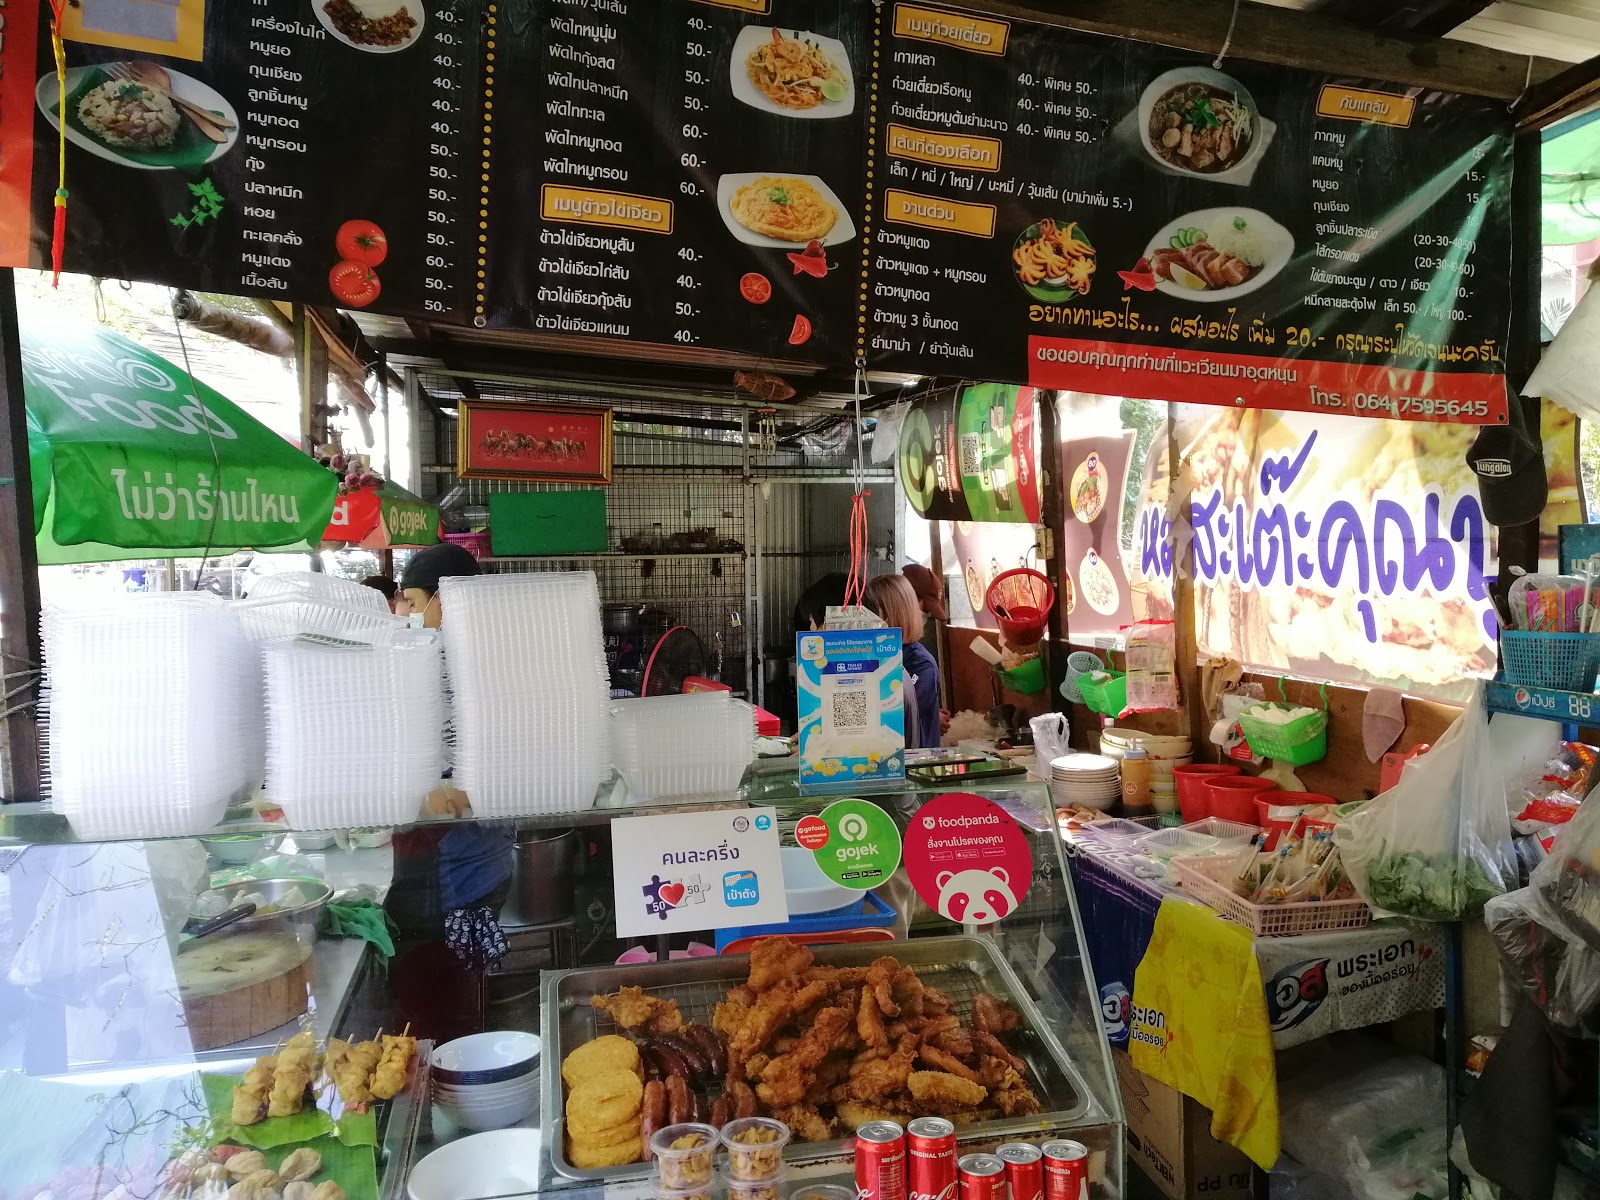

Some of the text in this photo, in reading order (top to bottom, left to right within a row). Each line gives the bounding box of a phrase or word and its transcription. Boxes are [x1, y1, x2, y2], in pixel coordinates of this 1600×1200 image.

[434, 9, 464, 24] 40.-
[687, 18, 712, 30] 40.-
[251, 16, 326, 40] เครื่องในไก่
[551, 17, 616, 43] ผัดไทหมูนุ่ม
[907, 18, 991, 47] เมนูก๋วยเตี๋ยว
[435, 33, 462, 45] 40.-
[250, 41, 291, 56] หมูยอ
[549, 43, 615, 70] ผัดไทกุ้งสด
[687, 42, 711, 57] 50.-
[434, 55, 461, 67] 40.-
[894, 52, 935, 66] เกาเหลา
[249, 65, 302, 81] กุนเชียง
[685, 70, 709, 84] 50.-
[433, 77, 461, 90] 40.-
[548, 72, 628, 100] ผัดไทปลาหมึก
[893, 75, 971, 104] ก๋วยเตี๋ยวเรือหมู
[1018, 73, 1097, 94] 40.- พิเศษ 50.-
[248, 87, 307, 110] ลูกชิ้นหมู
[432, 100, 460, 112] 40.-
[684, 96, 709, 111] 50.-
[547, 100, 605, 121] ผัดไททะเล
[891, 103, 1008, 132] ก๋วยเตี๋ยวหมูต้มยำมะนาว
[1017, 98, 1096, 121] 40.- พิเศษ 50.-
[248, 112, 299, 128] หมูทอด
[431, 122, 459, 134] 40.-
[683, 124, 708, 138] 60.-
[1017, 123, 1096, 143] 40.- พิเศษ 50.-
[1314, 130, 1346, 148] กากหมู
[247, 135, 306, 152] หมูกรอบ
[545, 129, 622, 152] ผัดไทหมูทอด
[893, 134, 991, 162] เส้นที่ต้องเลือก
[431, 144, 458, 157] 50.-
[246, 156, 265, 172] กุ้ง
[681, 153, 706, 167] 60.-
[1312, 155, 1343, 172] แคบหมู
[430, 166, 457, 179] 50.-
[544, 158, 627, 181] ผัดไทหมูกรอบ
[1466, 171, 1486, 182] 15.-
[245, 182, 302, 199] ปลาหมึก
[680, 182, 704, 195] 60.-
[890, 161, 1132, 211] เล็ก / หมี่ / ใหญ่ / บะหมี่ / วุ้นเส้น (มาม่าเพิ่ม 5.-)
[1312, 177, 1339, 192] หมูยอ
[429, 189, 456, 201] 50.-
[244, 207, 275, 219] หอย
[554, 195, 662, 223] เมนูข้าวไข่เจียว
[902, 202, 955, 221] จานด่วน
[1313, 200, 1350, 213] กุนเชียง
[428, 211, 455, 223] 50.-
[243, 230, 302, 245] ทะเลคลั่ง
[427, 233, 454, 246] 50.-
[540, 229, 634, 254] ข้าวไข่เจียวหมูสับ
[878, 229, 930, 249] ข้าวหมูแดง
[242, 253, 291, 267] หมูแดง
[426, 256, 453, 268] 60.-
[678, 248, 703, 261] 40.-
[539, 258, 629, 280] ข้าวไข่เจียวไก่สับ
[876, 256, 928, 275] ข้าวหมูแดง
[945, 268, 986, 283] หมูกรอบ
[242, 272, 287, 289] เนื้อสับ
[425, 278, 452, 290] 50.-
[677, 275, 701, 288] 40.-
[1370, 276, 1374, 288] /
[1379, 276, 1398, 289] ดาว
[1401, 278, 1406, 289] /
[1410, 276, 1430, 292] เจียว
[538, 286, 631, 310] ข้าวไข่เจียวกุ้งสับ
[875, 282, 929, 302] ข้าวหมูทอด
[1454, 287, 1474, 299] 10.-
[425, 300, 452, 312] 50.-
[676, 302, 700, 316] 50.-
[1304, 294, 1377, 312] หมึกสายสะดุ้งไฟ
[1384, 298, 1399, 313] เล็ก
[1403, 302, 1422, 314] 50.-
[1447, 310, 1472, 322] 100.-
[536, 314, 629, 335] ข้าวไข่เจียวแหนม
[874, 309, 958, 330] ข้าวหมู 3 ชั้นทอด
[1029, 297, 1159, 333] อยากทานอะไร...
[1171, 305, 1239, 341] ผสมอะไร
[1248, 312, 1275, 344] เพิ่ม
[1286, 326, 1326, 348] 20.-
[674, 330, 699, 342] 40.-
[872, 338, 973, 358] ยำมาม่า / ยำวุ้นเส้น
[1309, 386, 1346, 407] โทร.
[34, 373, 238, 440] Food
[934, 424, 947, 491] gojek
[111, 468, 300, 524] ไม่ว่าร้านไหน
[399, 509, 428, 536] gojek
[876, 645, 897, 653] เป๋าตัง
[804, 824, 826, 834] gofood
[937, 813, 1000, 832] foodpanda
[661, 838, 740, 866] คนละครึ่ง
[836, 843, 879, 862] gojek
[652, 884, 700, 912] 50 50
[727, 888, 757, 901] เป๋าตัง
[1338, 939, 1416, 979] พระเอก
[1342, 962, 1416, 996] ของมื้ออร่อย
[909, 1148, 937, 1159] ORIGINAL
